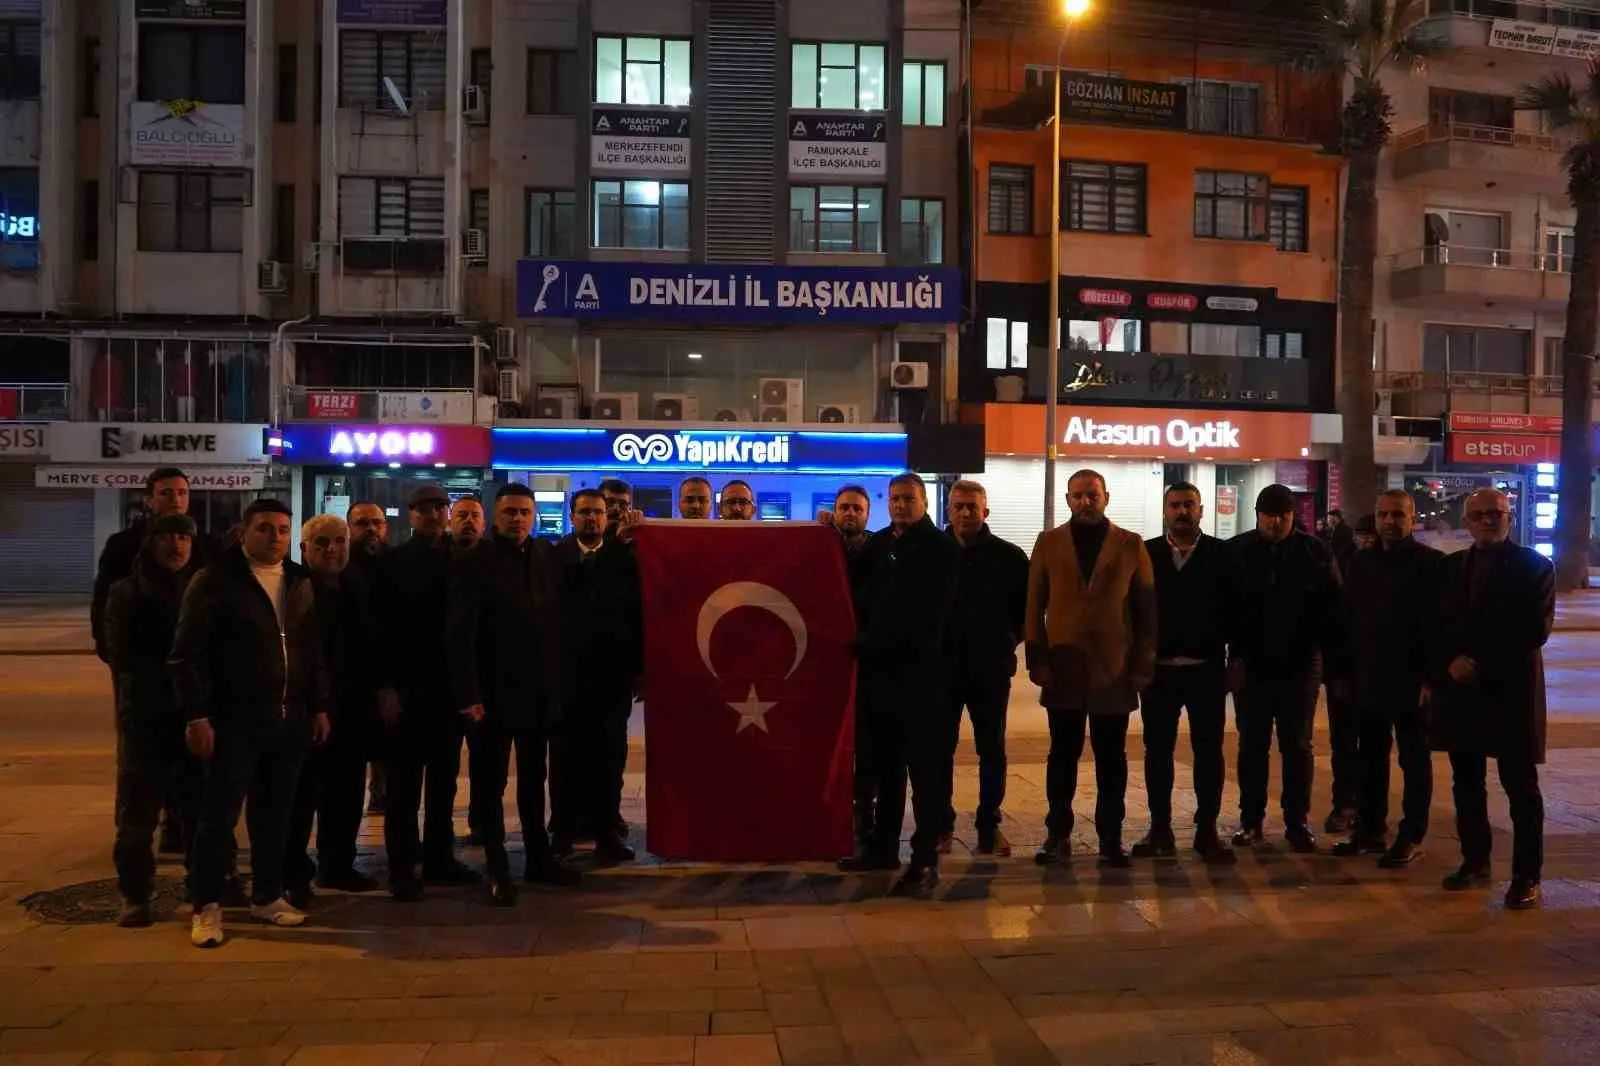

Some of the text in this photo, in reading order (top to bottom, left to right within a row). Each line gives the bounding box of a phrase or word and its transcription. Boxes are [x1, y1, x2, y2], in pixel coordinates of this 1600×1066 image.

[619, 117, 670, 126] ANAHTAR
[816, 122, 864, 131] ANAHTAR
[597, 152, 686, 165] İLÇE BAŞKANLIĞI
[807, 146, 869, 156] PAMUKKALE
[793, 157, 881, 168] İLÇE BAŞKANLIĞI
[576, 273, 599, 300] A
[630, 273, 942, 315] DENİZLİ İL BAŞKANLIĞI
[1063, 416, 1239, 453] Atasun Optik
[141, 434, 216, 452] MERVE
[329, 431, 434, 455] AVON
[1464, 441, 1536, 457] etstur
[48, 474, 251, 488] MERVE ÇORA AMAŞIR
